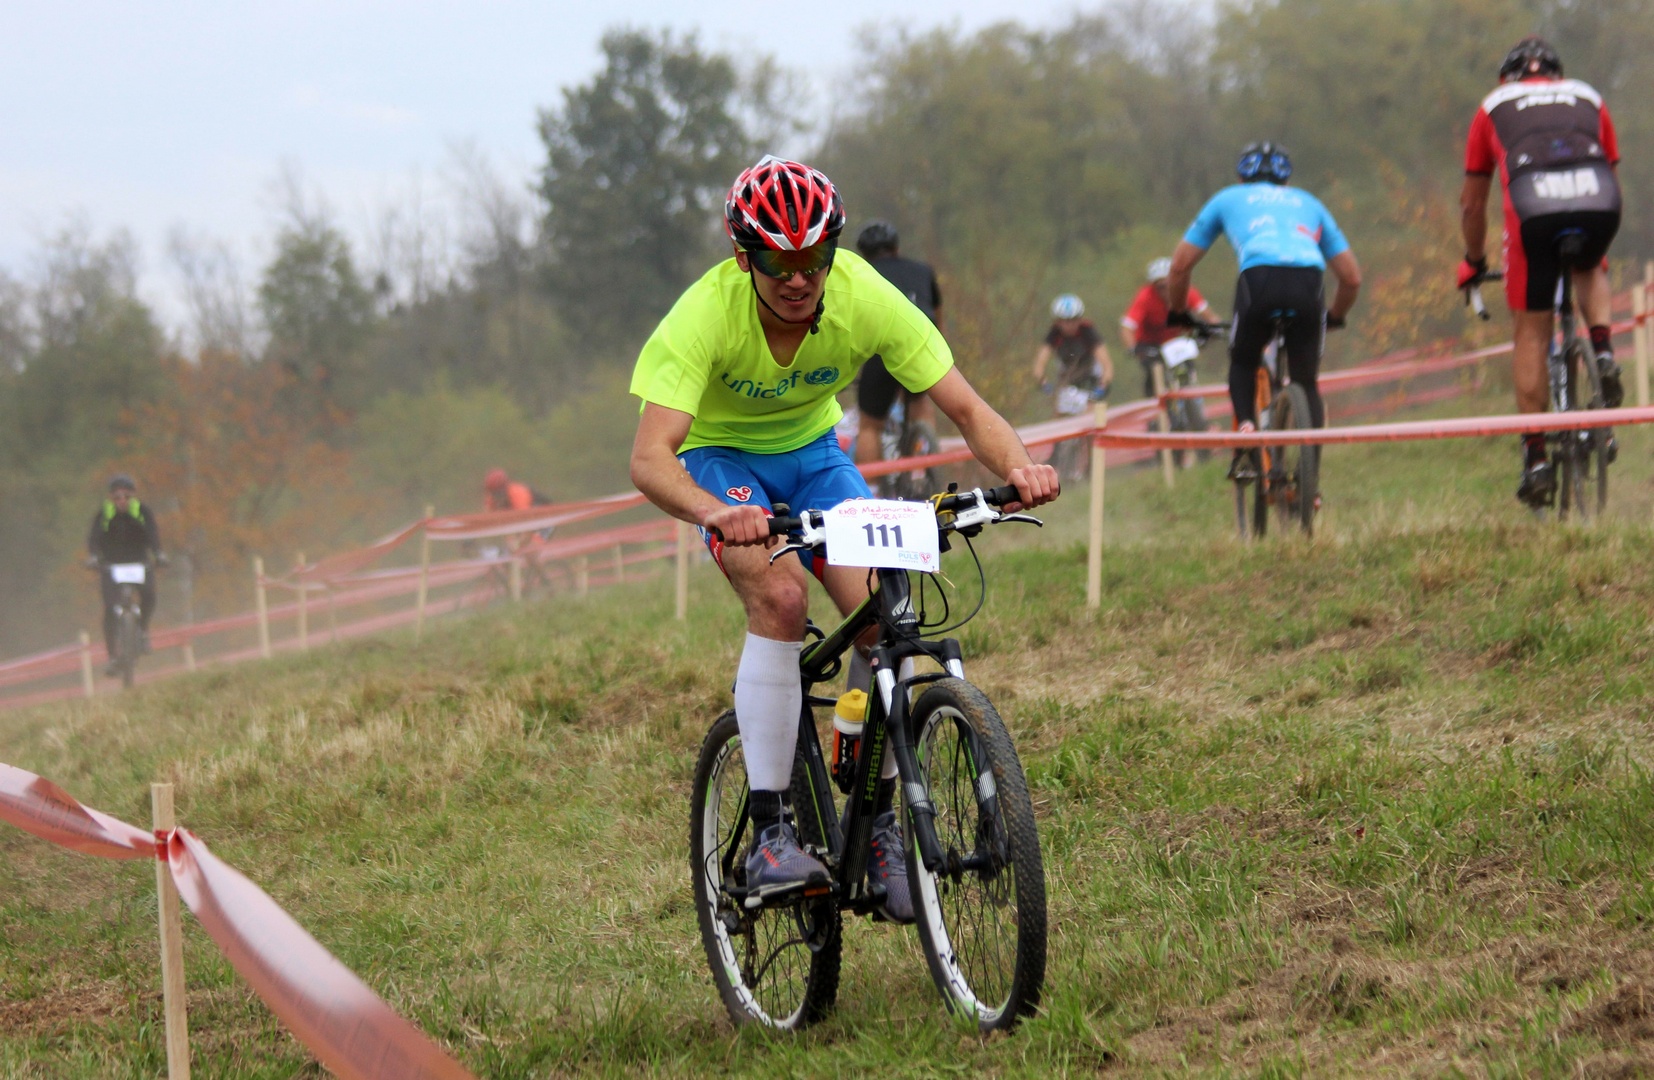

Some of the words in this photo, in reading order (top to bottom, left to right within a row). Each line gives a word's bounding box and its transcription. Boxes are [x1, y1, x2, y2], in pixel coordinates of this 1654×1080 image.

[721, 370, 802, 399] unicef
[870, 513, 898, 521] TURA
[862, 523, 903, 548] 111
[898, 552, 919, 560] PULS
